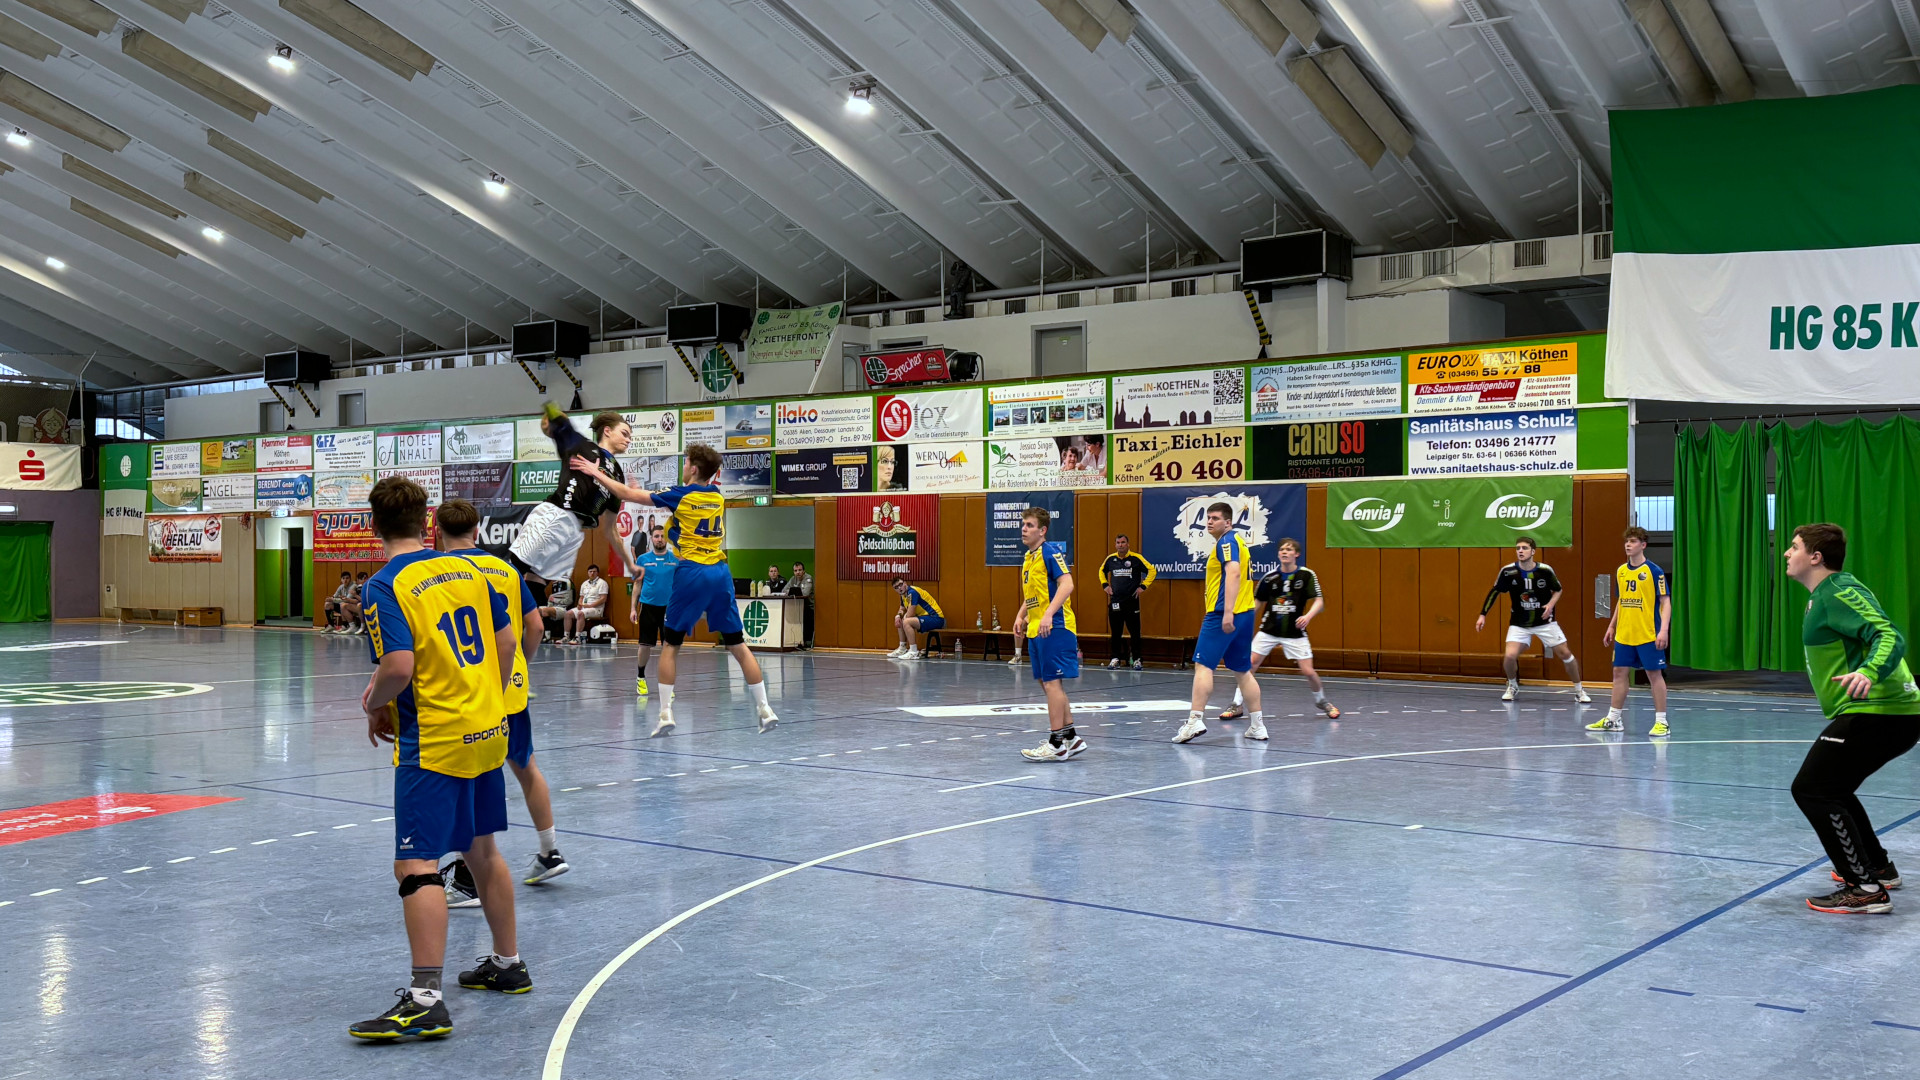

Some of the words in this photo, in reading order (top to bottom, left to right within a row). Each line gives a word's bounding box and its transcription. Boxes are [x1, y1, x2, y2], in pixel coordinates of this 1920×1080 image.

[759, 325, 786, 334] FANCLUB
[1770, 305, 1823, 350] HG
[1832, 303, 1882, 350] 85
[1520, 348, 1568, 362] Köthen
[888, 353, 922, 380] Sprecher
[1449, 370, 1478, 379] (03496)
[1482, 368, 1499, 377] 55
[1504, 366, 1520, 375] 77
[1524, 364, 1541, 374] 88
[1128, 379, 1210, 393] www.IN-KOETHEN.de
[1420, 380, 1516, 395] Kfz-Sachverständigenbüro
[995, 392, 1030, 400] BERNBURG
[1304, 392, 1312, 400] und
[1313, 389, 1340, 402] Jugenddorf
[1345, 388, 1376, 398] Förderschule
[1376, 386, 1396, 396] Belleben
[1416, 396, 1447, 405] Demmler
[1456, 394, 1473, 402] Koch
[778, 405, 818, 424] ilako
[1410, 418, 1514, 434] Sanitätshaus
[1518, 414, 1575, 428] Schulz
[262, 438, 286, 449] Hammer
[316, 434, 336, 448] GFZ
[400, 435, 432, 447] HOTEL
[1020, 442, 1036, 450] Jessica
[1038, 441, 1054, 450] Singer
[1426, 440, 1472, 450] Telefon:
[1475, 438, 1510, 449] 03496
[1514, 436, 1556, 447] 214777
[721, 454, 772, 470] WERBUNG
[1288, 458, 1330, 466] RISTORANTE
[1426, 454, 1460, 462] Leipziger
[1476, 452, 1497, 460] 63-64
[1530, 449, 1557, 457] Köthen
[781, 464, 804, 472] WIMEX
[805, 463, 828, 472] GROUP
[940, 457, 963, 470] Optik
[1150, 461, 1182, 481] 40
[1192, 458, 1243, 480] 460
[1412, 461, 1574, 475] www.sanitaetshaus-schulz.de
[394, 468, 440, 478] Reparaturen
[1115, 474, 1144, 482] Köthen
[202, 480, 236, 497] ENGEL
[258, 480, 282, 488] BERENDT
[991, 480, 998, 488] An
[994, 502, 1030, 511] WOHNEIGENTUM
[994, 512, 1012, 520] EINFACH
[694, 516, 723, 538] 44
[994, 520, 1020, 529] VERKAUFEN
[166, 533, 202, 546] HERLAU
[858, 535, 914, 554] Feldschlößchen
[862, 560, 876, 573] Freu
[877, 560, 890, 573] Dich
[892, 560, 910, 574] drauf.
[411, 586, 421, 598] SV
[421, 571, 474, 592] LANGENWEDDINGEN
[1284, 580, 1290, 592] 2
[1524, 578, 1532, 590] 11
[1626, 580, 1637, 592] 79
[436, 606, 484, 668] 19
[463, 726, 500, 744] SPORT
